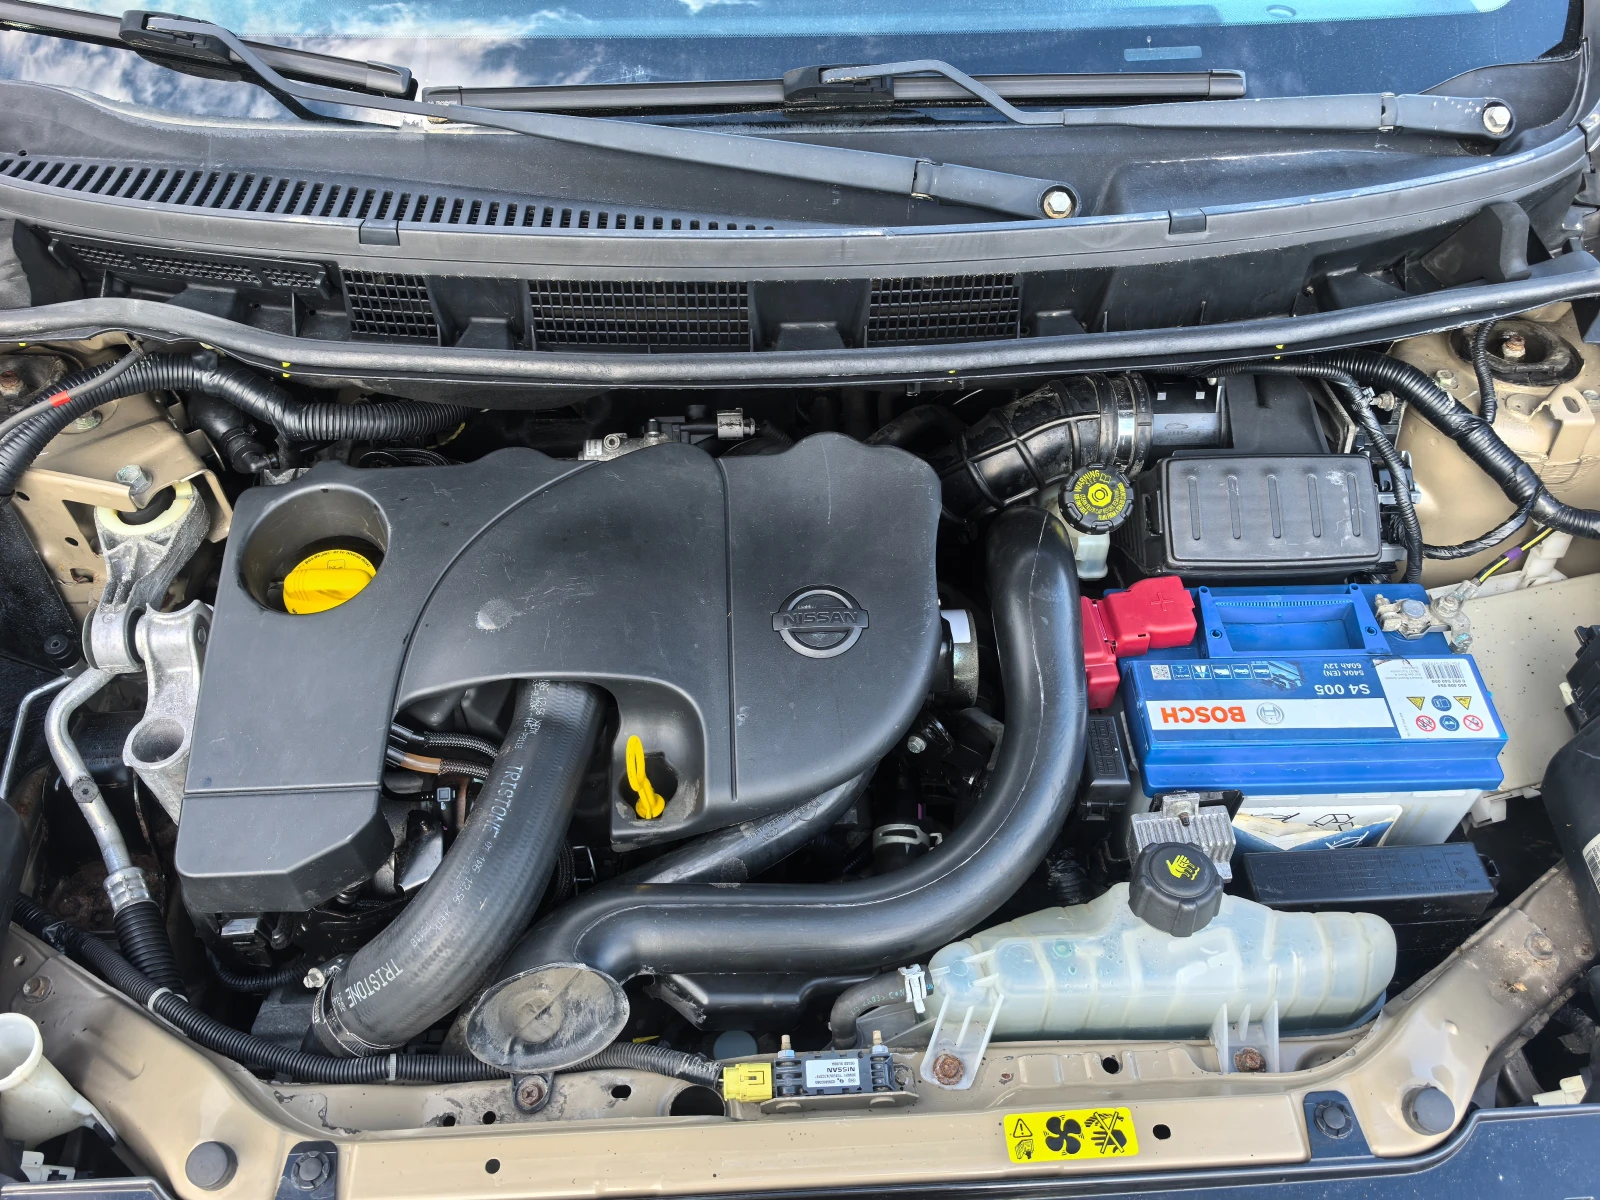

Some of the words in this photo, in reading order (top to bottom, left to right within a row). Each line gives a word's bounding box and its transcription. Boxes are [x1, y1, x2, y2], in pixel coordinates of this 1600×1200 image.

[1074, 469, 1100, 492] WARNING
[782, 611, 858, 626] NISSAN
[1323, 669, 1341, 677] (EN)
[1314, 683, 1345, 695] 005
[1348, 683, 1371, 695] S4
[1160, 706, 1246, 724] BOSCH
[482, 764, 524, 839] TRISTONE
[345, 958, 404, 1009] TRISTONE
